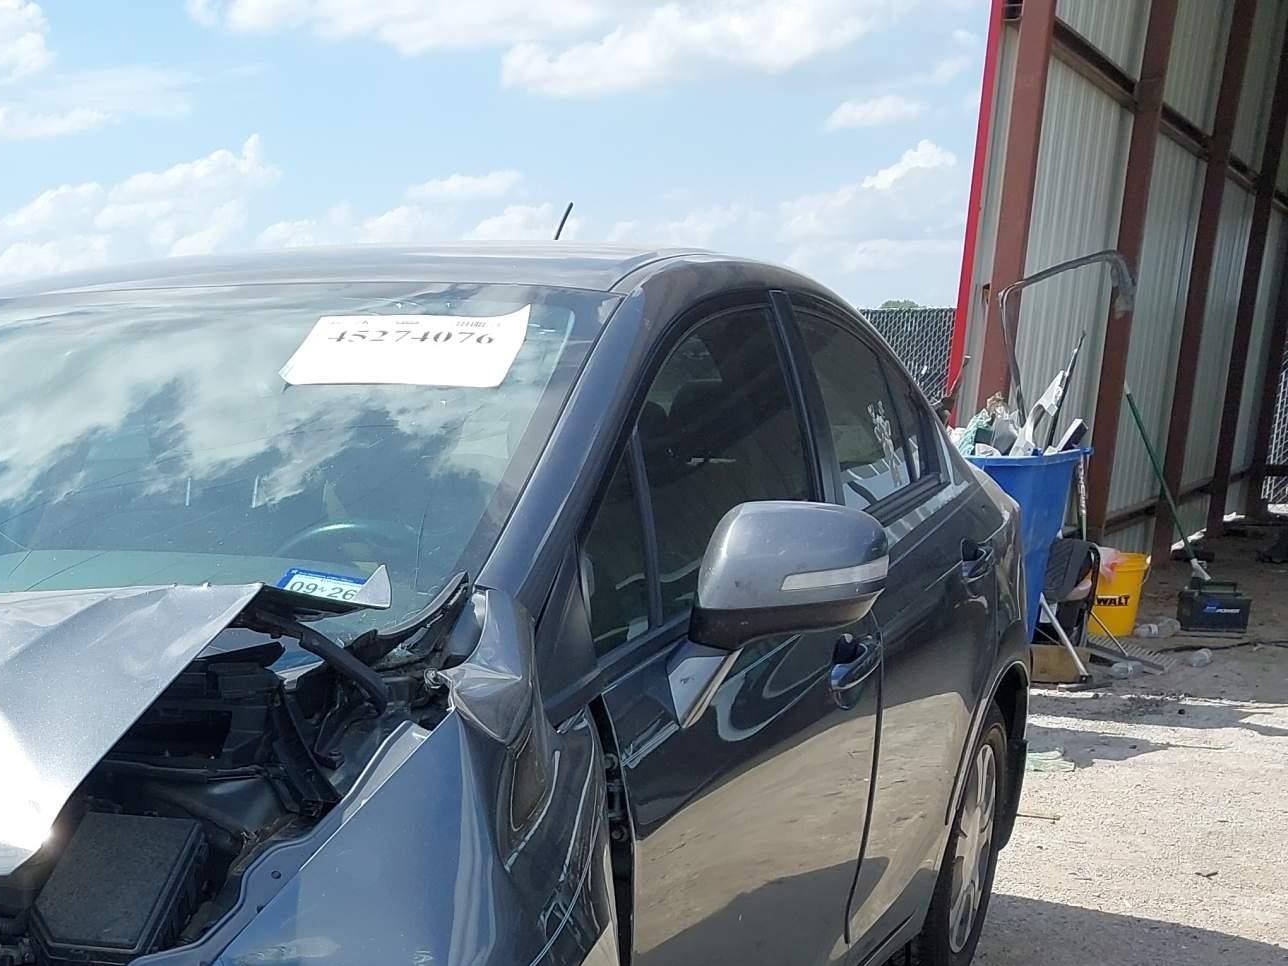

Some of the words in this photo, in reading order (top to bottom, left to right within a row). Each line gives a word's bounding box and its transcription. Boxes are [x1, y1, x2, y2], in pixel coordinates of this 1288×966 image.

[327, 330, 495, 345] 45274076
[290, 581, 318, 594] 09
[327, 586, 357, 600] 26
[1096, 595, 1130, 606] WALT
